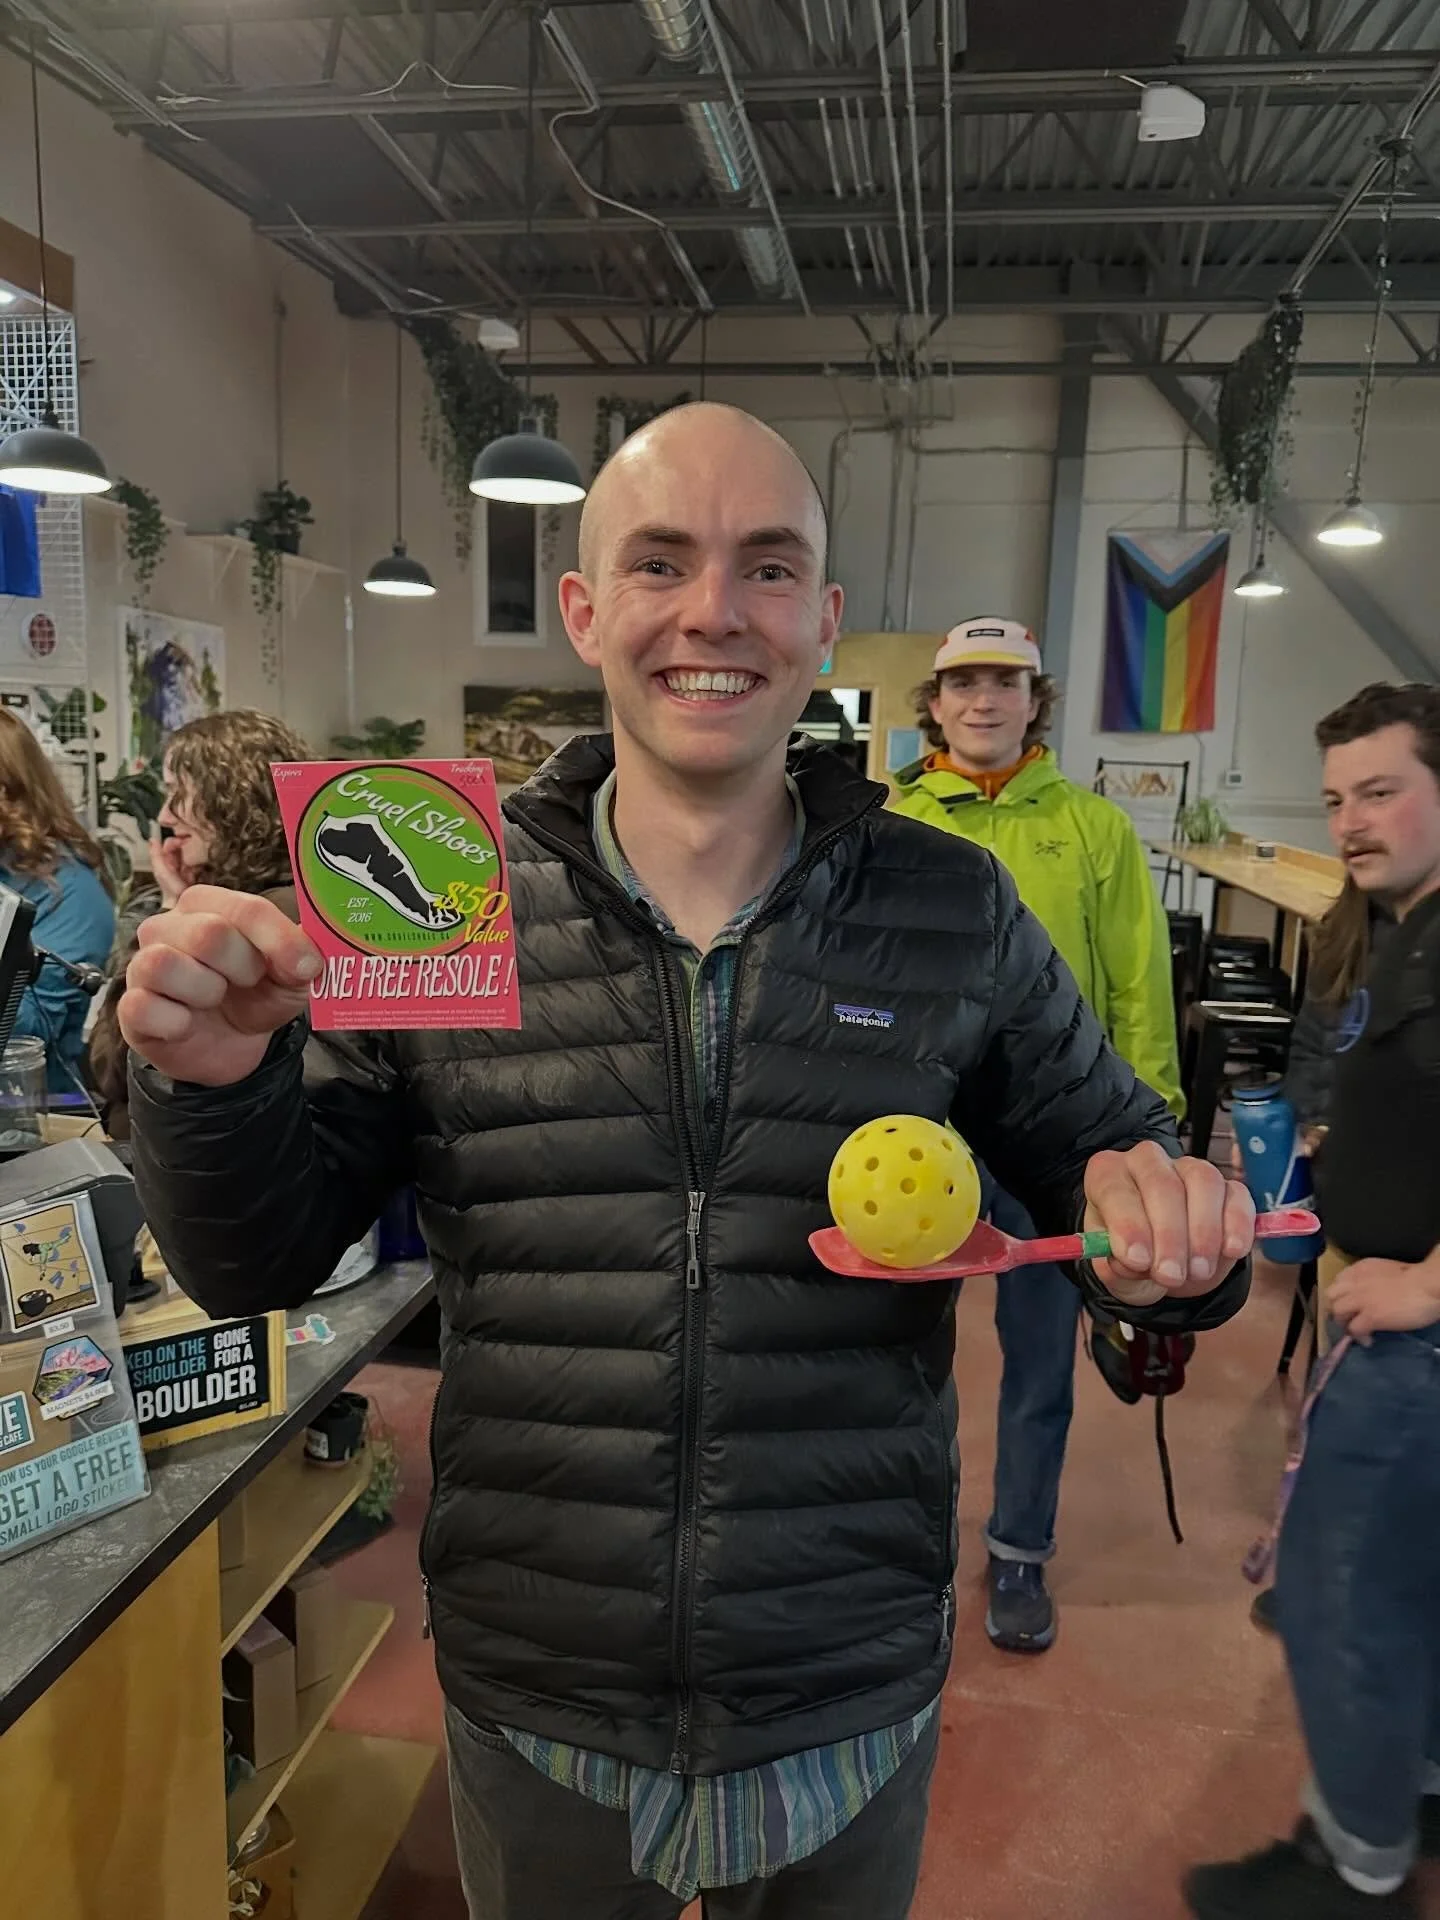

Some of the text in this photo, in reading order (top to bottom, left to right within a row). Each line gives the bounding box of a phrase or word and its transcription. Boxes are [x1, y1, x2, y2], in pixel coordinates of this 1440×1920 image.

[336, 773, 496, 864] Cruel Shoes
[434, 880, 509, 920] $50
[347, 912, 372, 923] 2016
[464, 921, 509, 945] Value
[311, 955, 355, 999] ONE
[358, 954, 414, 999] FREE
[415, 954, 501, 998] RESOLE
[839, 1014, 890, 1028] patagonia
[156, 1344, 176, 1363] ON
[180, 1337, 207, 1358] THE
[213, 1326, 251, 1350] GONE
[214, 1343, 254, 1368] FOR A
[133, 1356, 207, 1388] SHOULDER
[136, 1364, 257, 1424] BOULDER
[3, 1429, 24, 1446] CAFE
[0, 1471, 17, 1489] OW
[20, 1465, 33, 1479] US
[34, 1454, 59, 1472] YOUR
[60, 1438, 96, 1461] GOOGLE
[0, 1441, 134, 1525] GET A FREE
[0, 1515, 42, 1546] SMALL
[47, 1498, 79, 1524] LOGO
